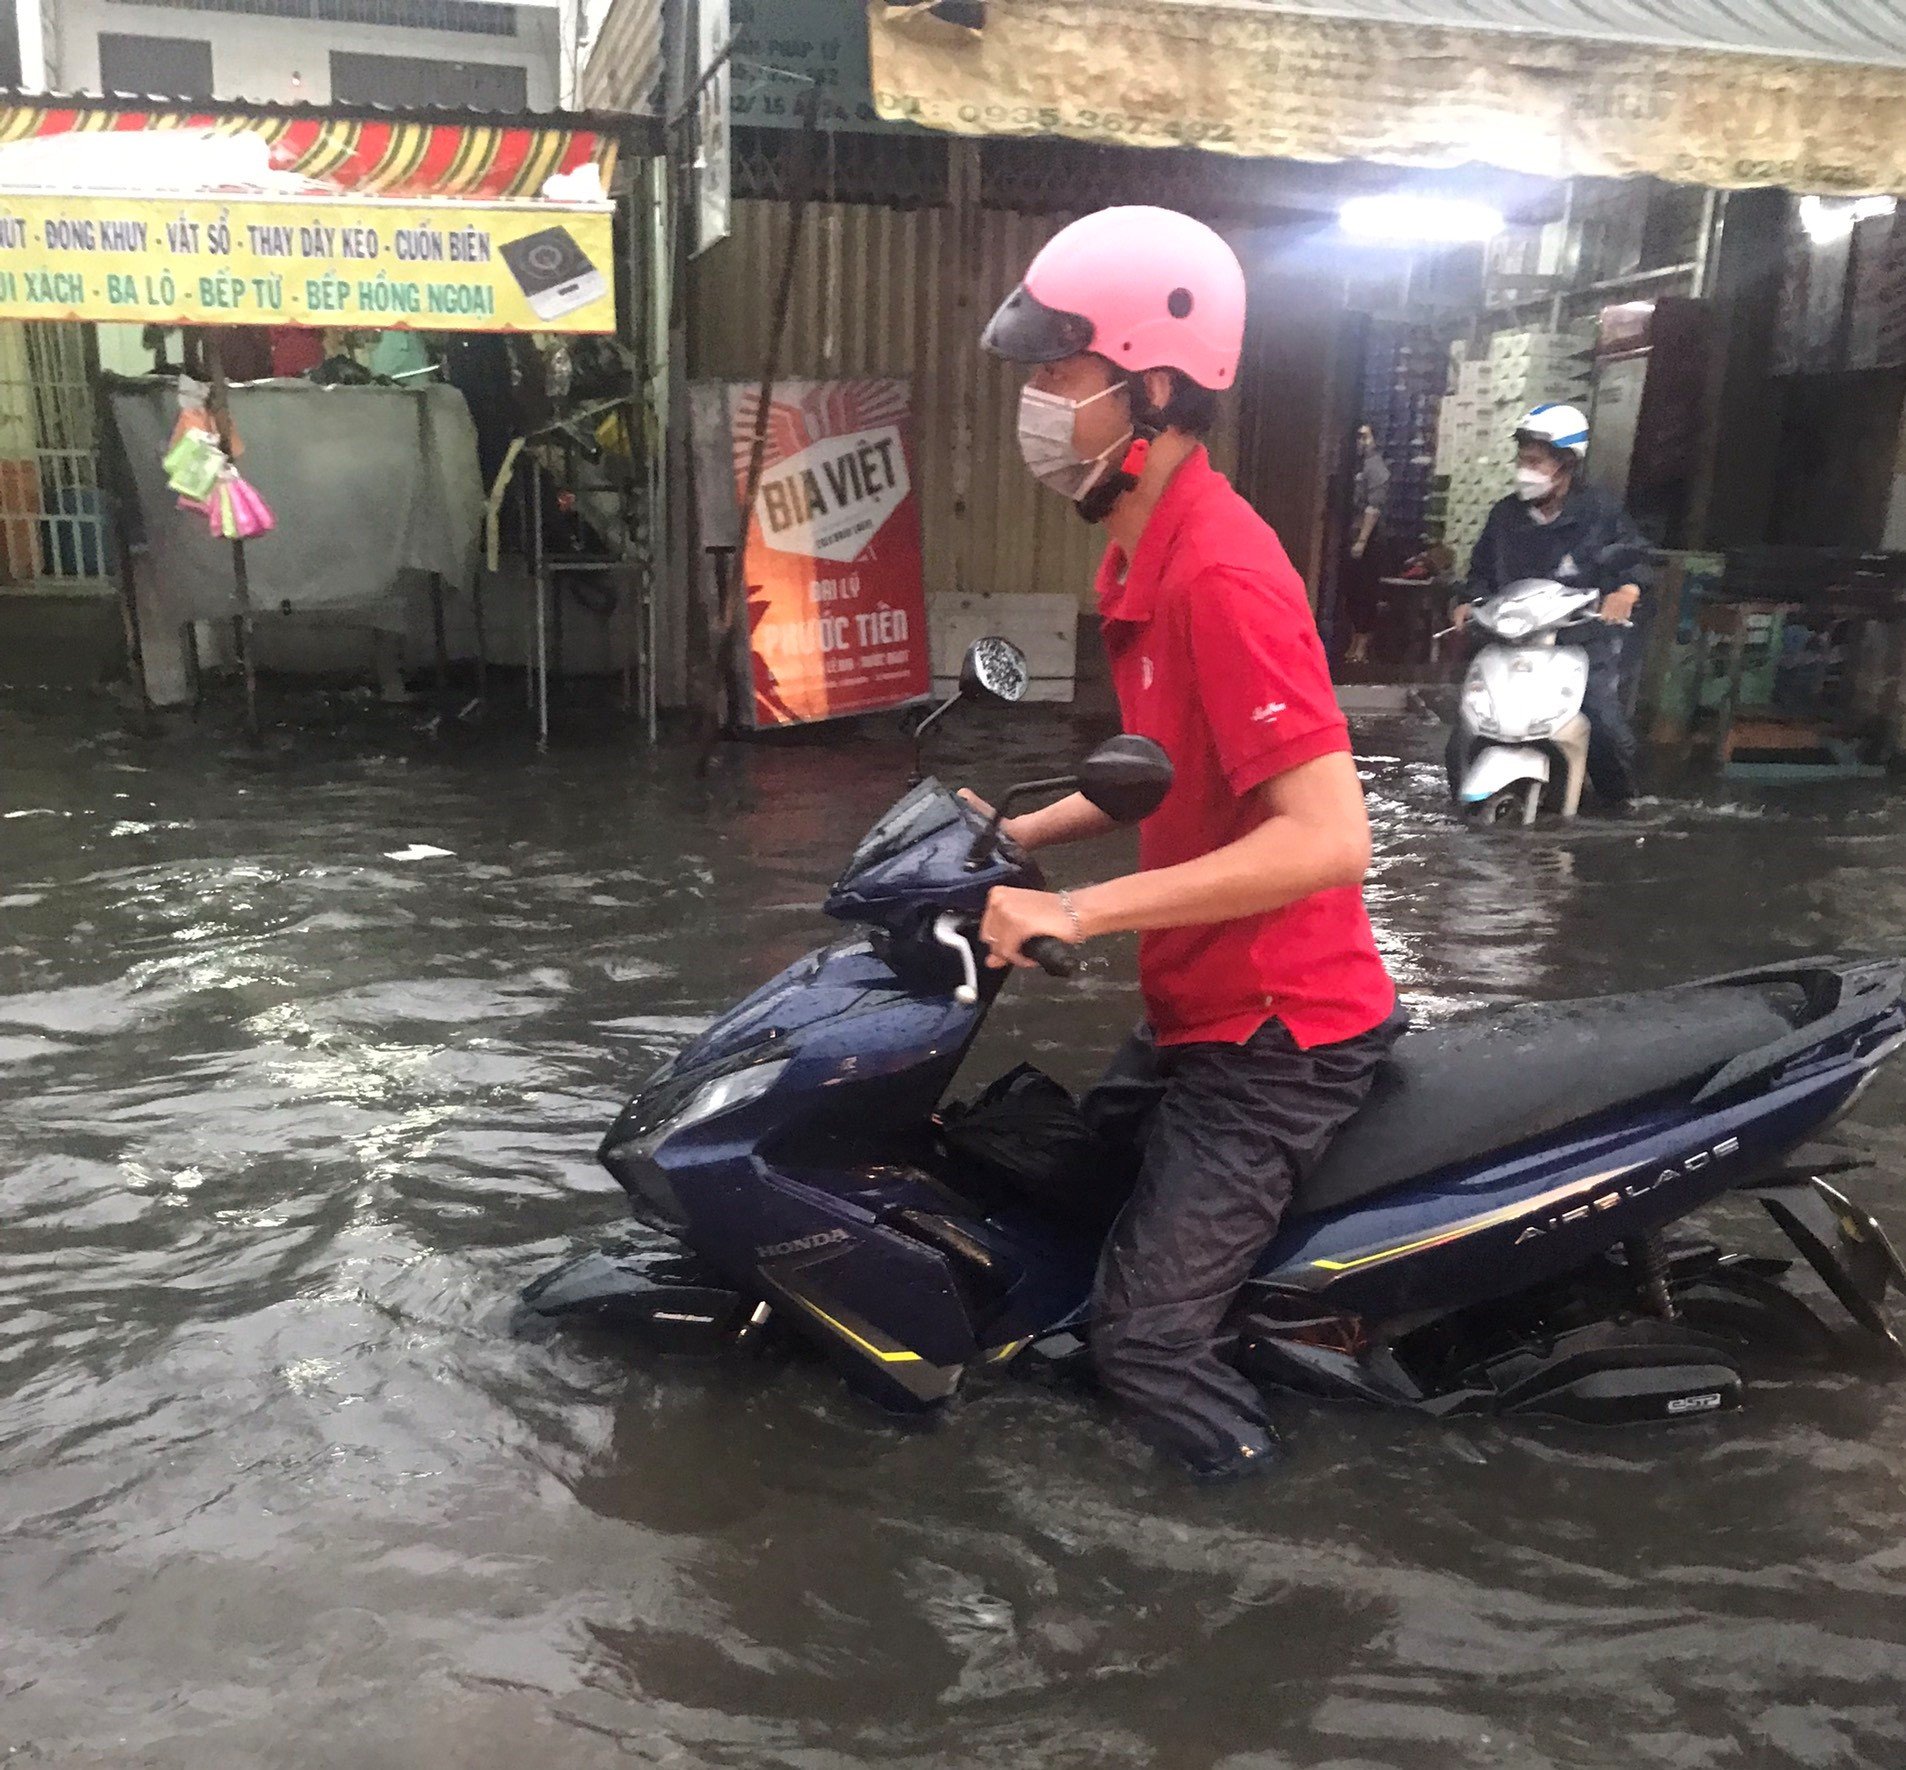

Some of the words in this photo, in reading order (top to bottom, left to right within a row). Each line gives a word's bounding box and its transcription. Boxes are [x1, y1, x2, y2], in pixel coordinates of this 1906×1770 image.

[99, 220, 148, 252] KHUY
[246, 224, 294, 257] THAY
[300, 218, 336, 259] DÂY
[341, 219, 379, 260] KÉO
[449, 222, 491, 263] BIÊN
[23, 264, 85, 304] XÁCH
[106, 273, 139, 306] BA
[145, 267, 176, 307] LÔ
[198, 265, 246, 309] BẾP
[251, 270, 283, 310] TỪ
[305, 265, 351, 311] BẾP
[427, 282, 495, 320] NGOẠI
[761, 468, 828, 534] BIA
[821, 436, 896, 508] VIỆT
[755, 1228, 850, 1258] HONDA
